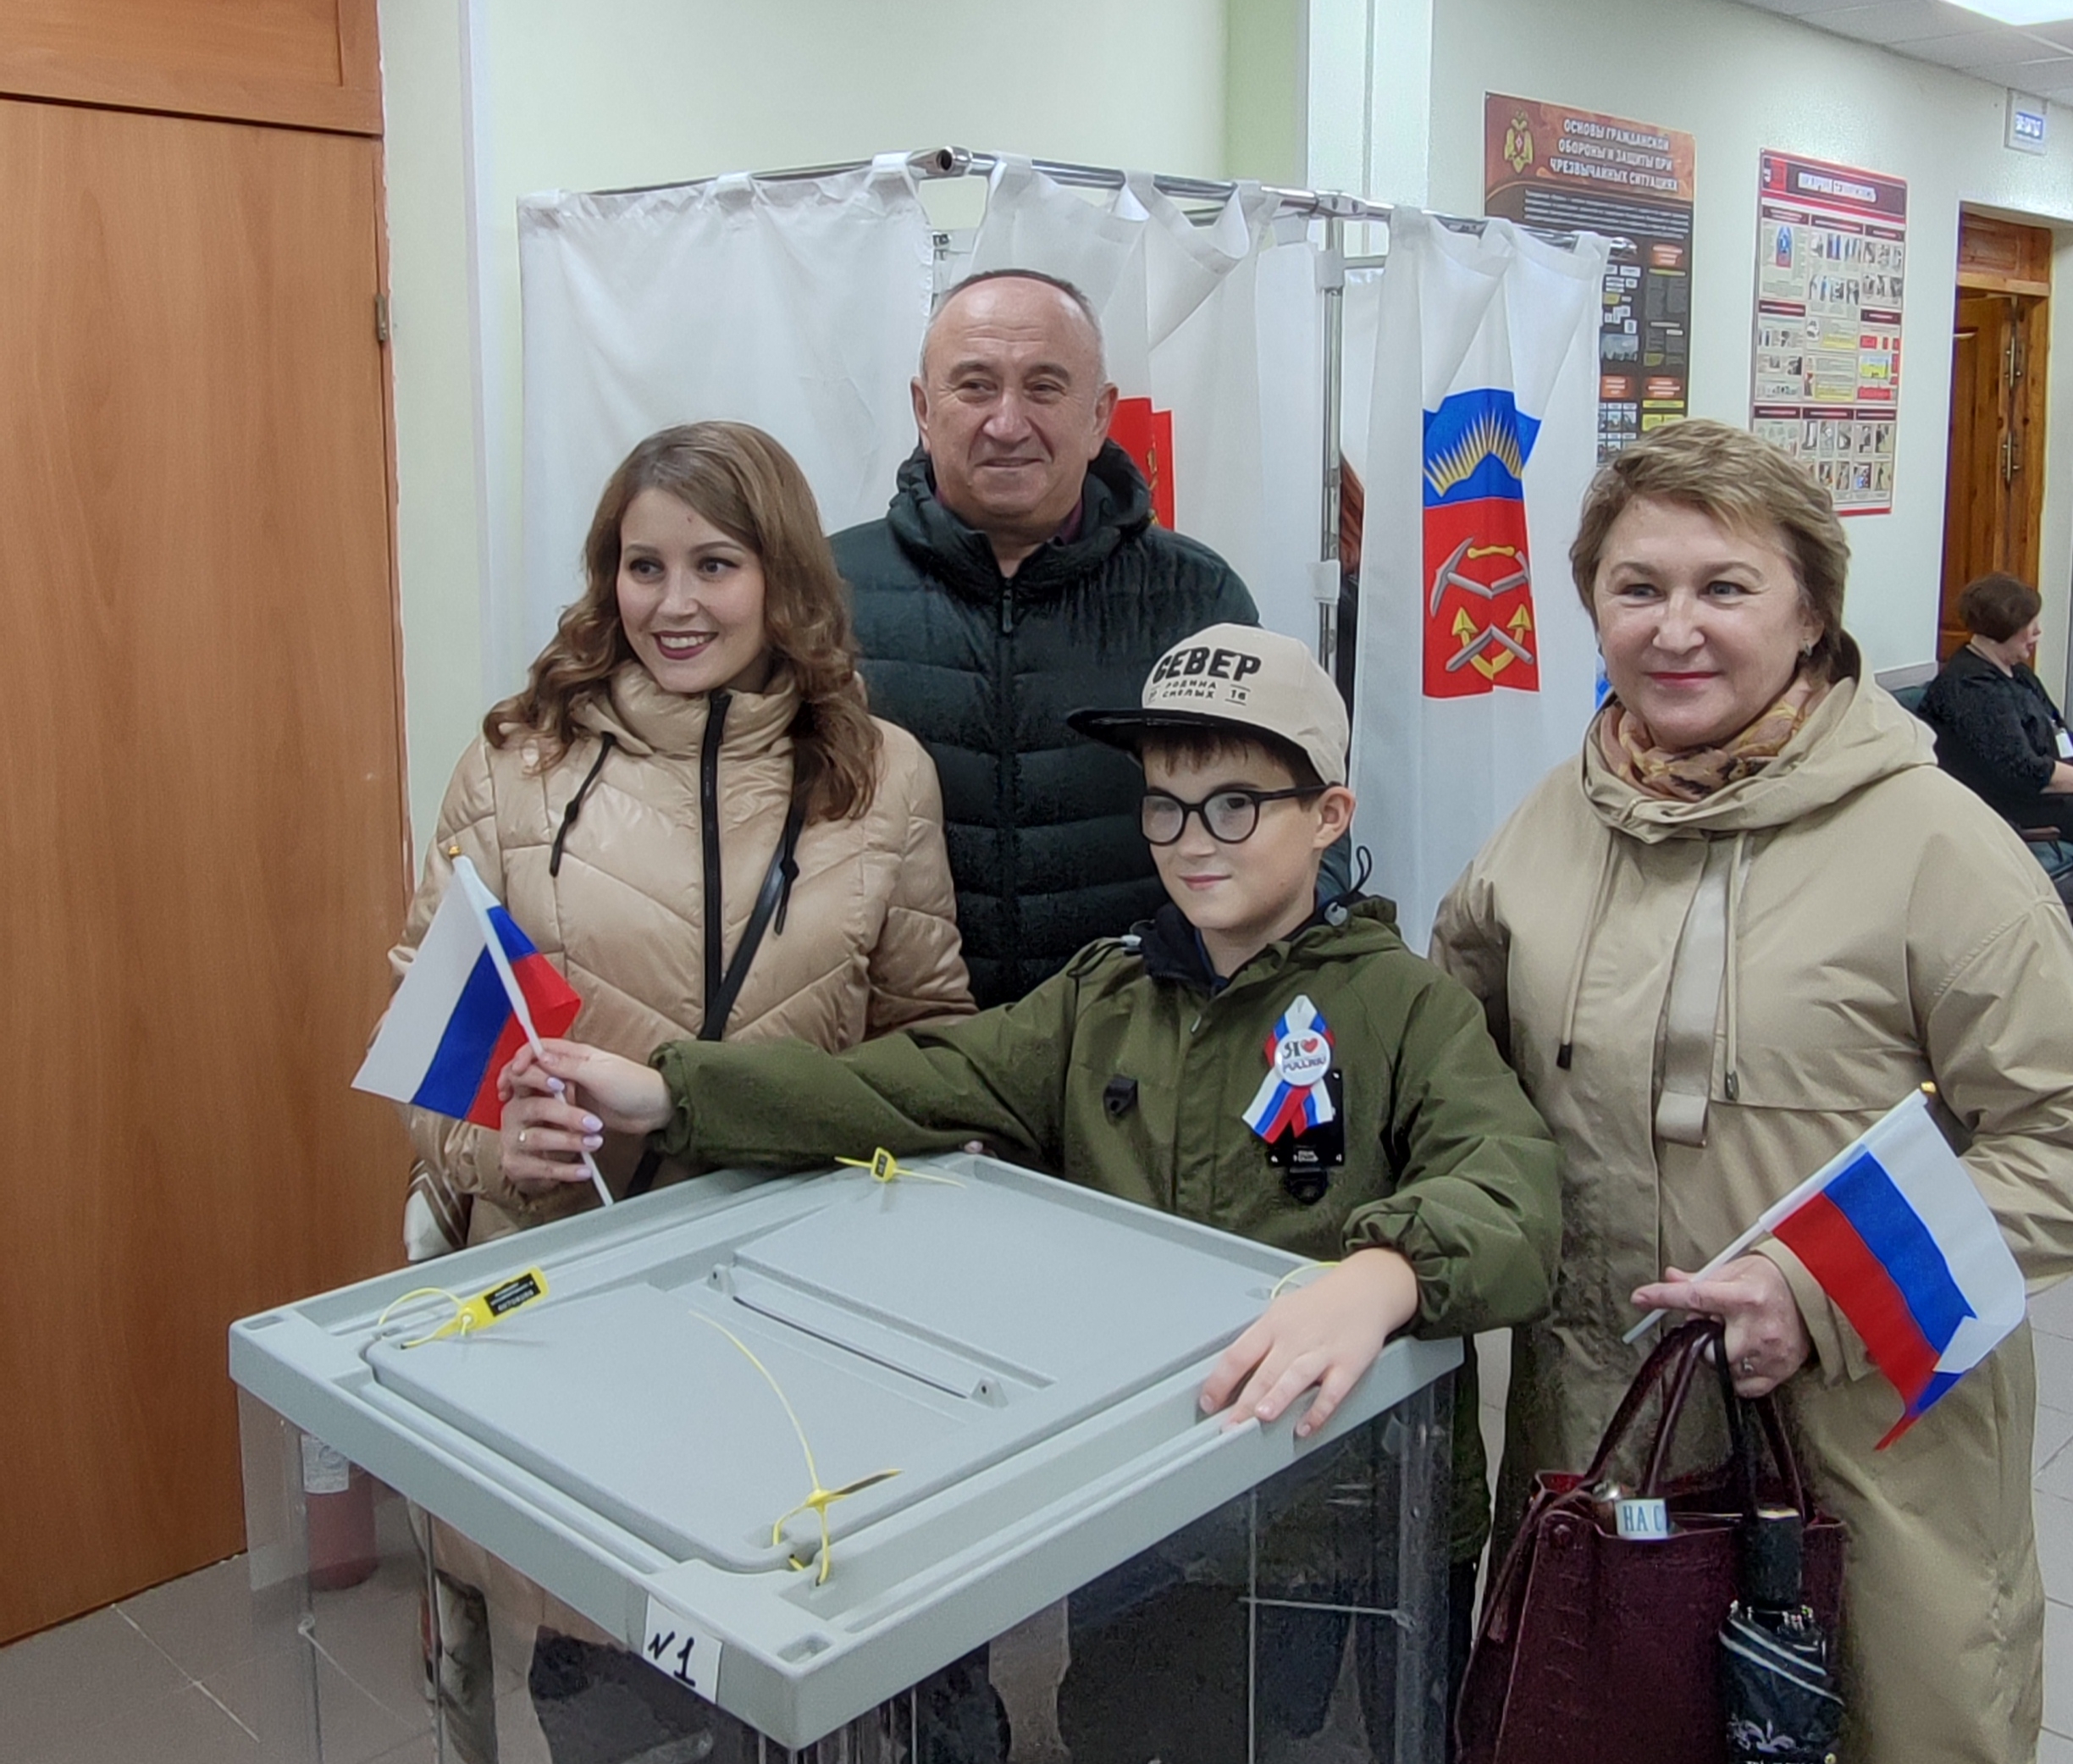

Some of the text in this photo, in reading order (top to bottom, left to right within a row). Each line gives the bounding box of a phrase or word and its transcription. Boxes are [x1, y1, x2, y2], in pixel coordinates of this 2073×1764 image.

[1564, 119, 1670, 151] ОСНОВЫ ГРАЖДАНСКОЙ
[1558, 138, 1672, 171] ОБОРОНЫ И ЗАЩИТЫ ПРИ
[1550, 158, 1628, 183] ЧРЕЗВЫЧАЙНЫХ
[1153, 646, 1262, 684] СЕВЕР
[1163, 688, 1214, 700] СМЕЛЫХ
[1165, 679, 1216, 689] РОДИНА
[1283, 1041, 1301, 1059] Я
